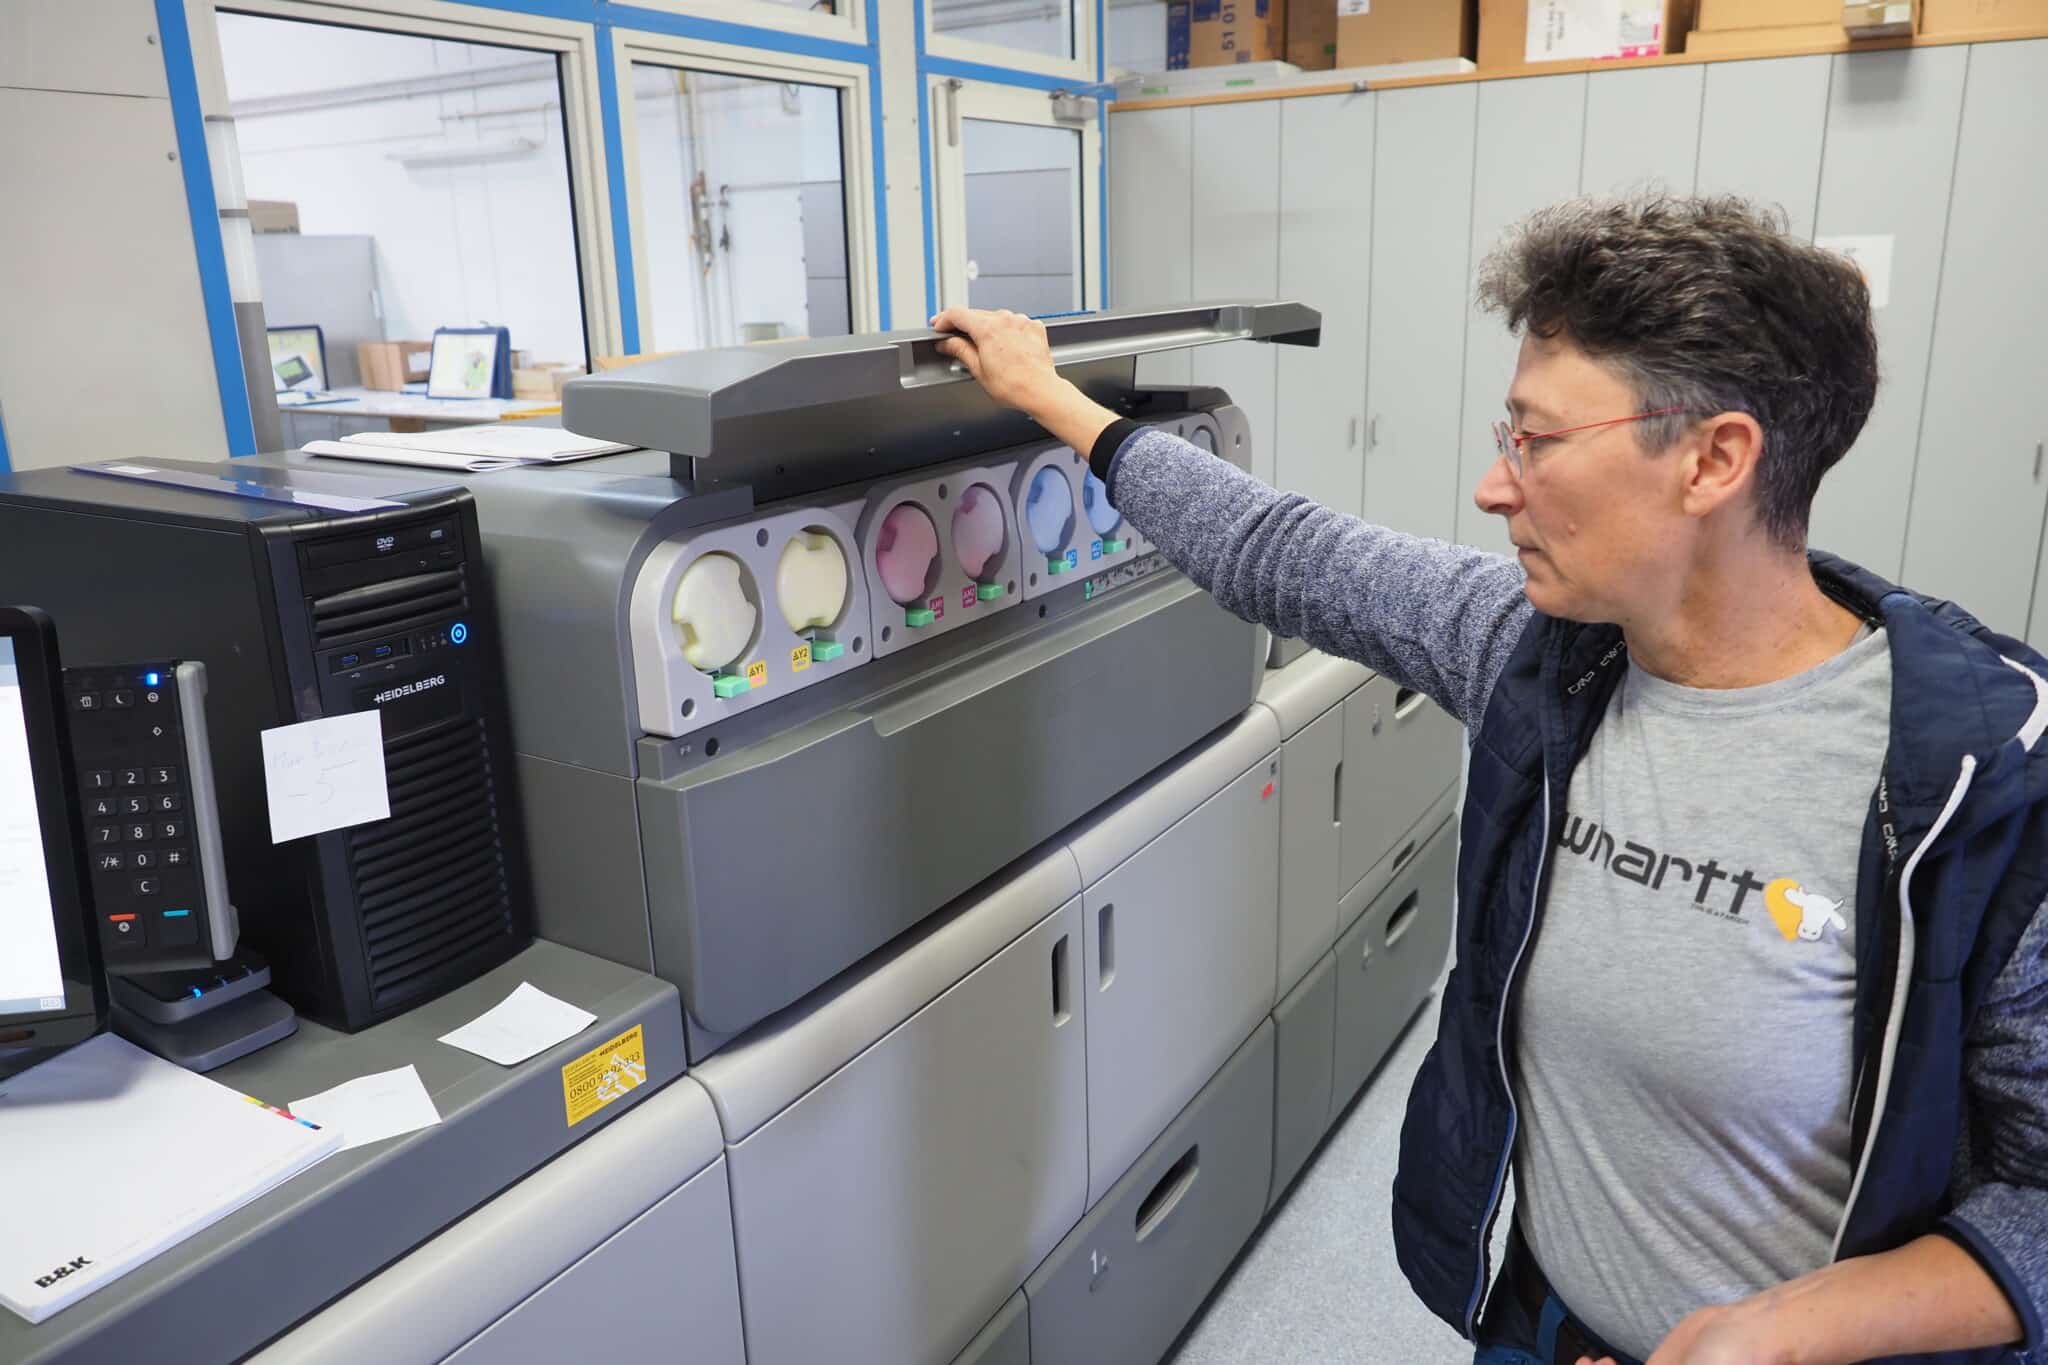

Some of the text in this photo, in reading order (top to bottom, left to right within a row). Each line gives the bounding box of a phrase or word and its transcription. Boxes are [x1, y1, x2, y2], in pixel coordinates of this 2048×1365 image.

[376, 536, 394, 546] DVD
[373, 674, 446, 704] HEIDELBERG
[95, 770, 168, 787] 1 2 3
[98, 797, 172, 813] 4 5 6
[102, 824, 176, 841] 7 8 9
[137, 854, 147, 866] 0
[168, 852, 180, 863] #
[140, 881, 150, 893] C
[599, 1032, 638, 1057] HEIDELBERG
[569, 1077, 596, 1099] 0800
[34, 1255, 93, 1288] B&K
